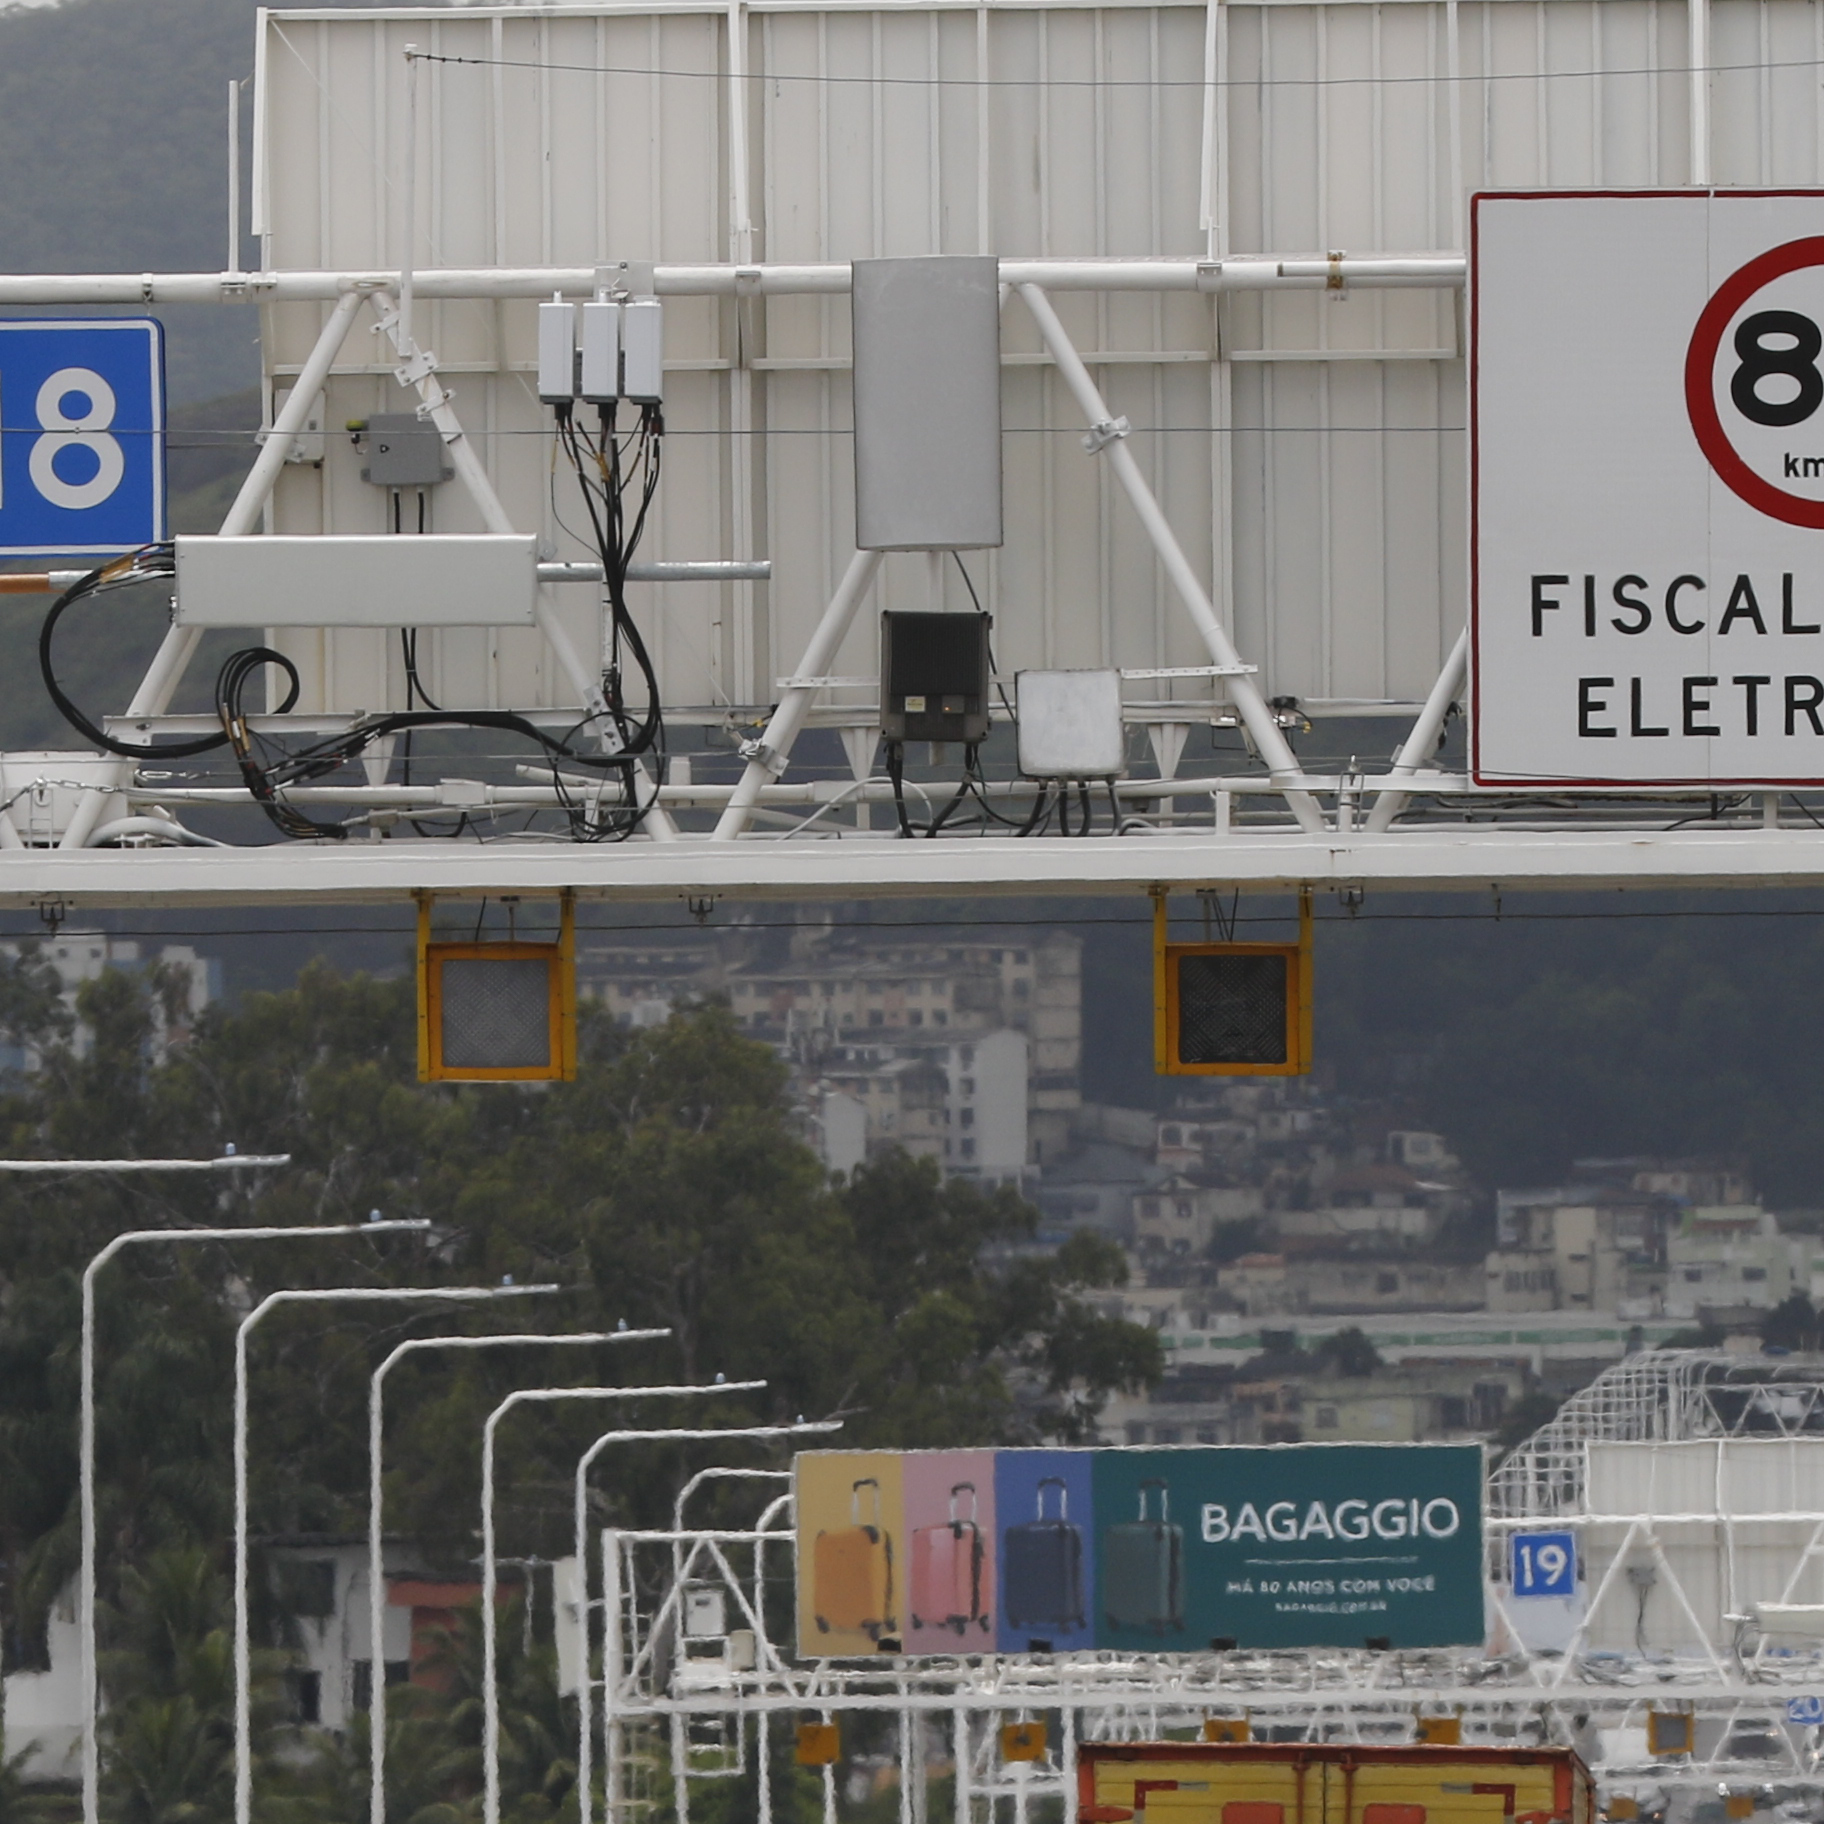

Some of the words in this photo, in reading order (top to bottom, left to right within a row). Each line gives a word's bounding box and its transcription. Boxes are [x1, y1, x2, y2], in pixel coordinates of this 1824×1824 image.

[1201, 1497, 1459, 1543] BAGAGGIO
[1287, 1579, 1335, 1595] ANOS
[1340, 1578, 1381, 1594] COM
[1386, 1574, 1436, 1592] VOCÊ
[1520, 1544, 1569, 1588] 19
